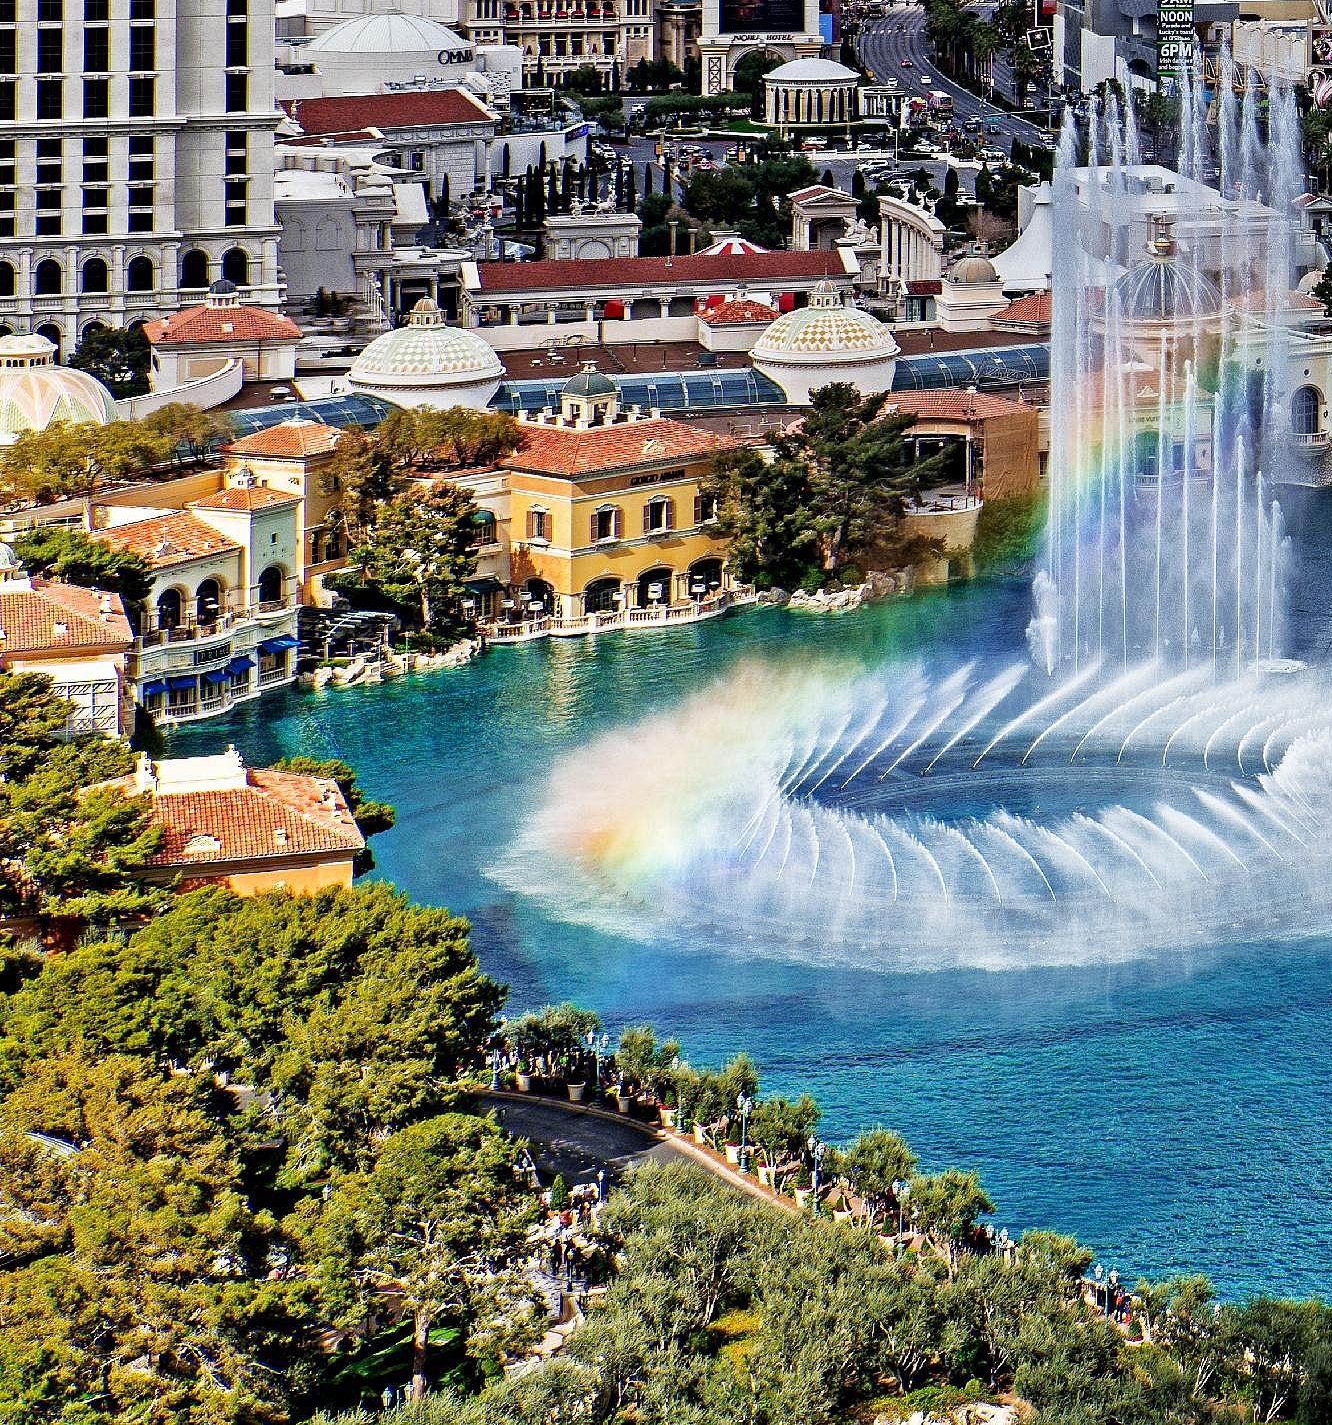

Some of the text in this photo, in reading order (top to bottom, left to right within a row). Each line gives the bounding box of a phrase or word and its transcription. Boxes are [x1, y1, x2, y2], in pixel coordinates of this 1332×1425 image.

[1161, 11, 1193, 22] NOON
[1161, 44, 1192, 56] 6PM
[437, 48, 475, 66] OMNIA
